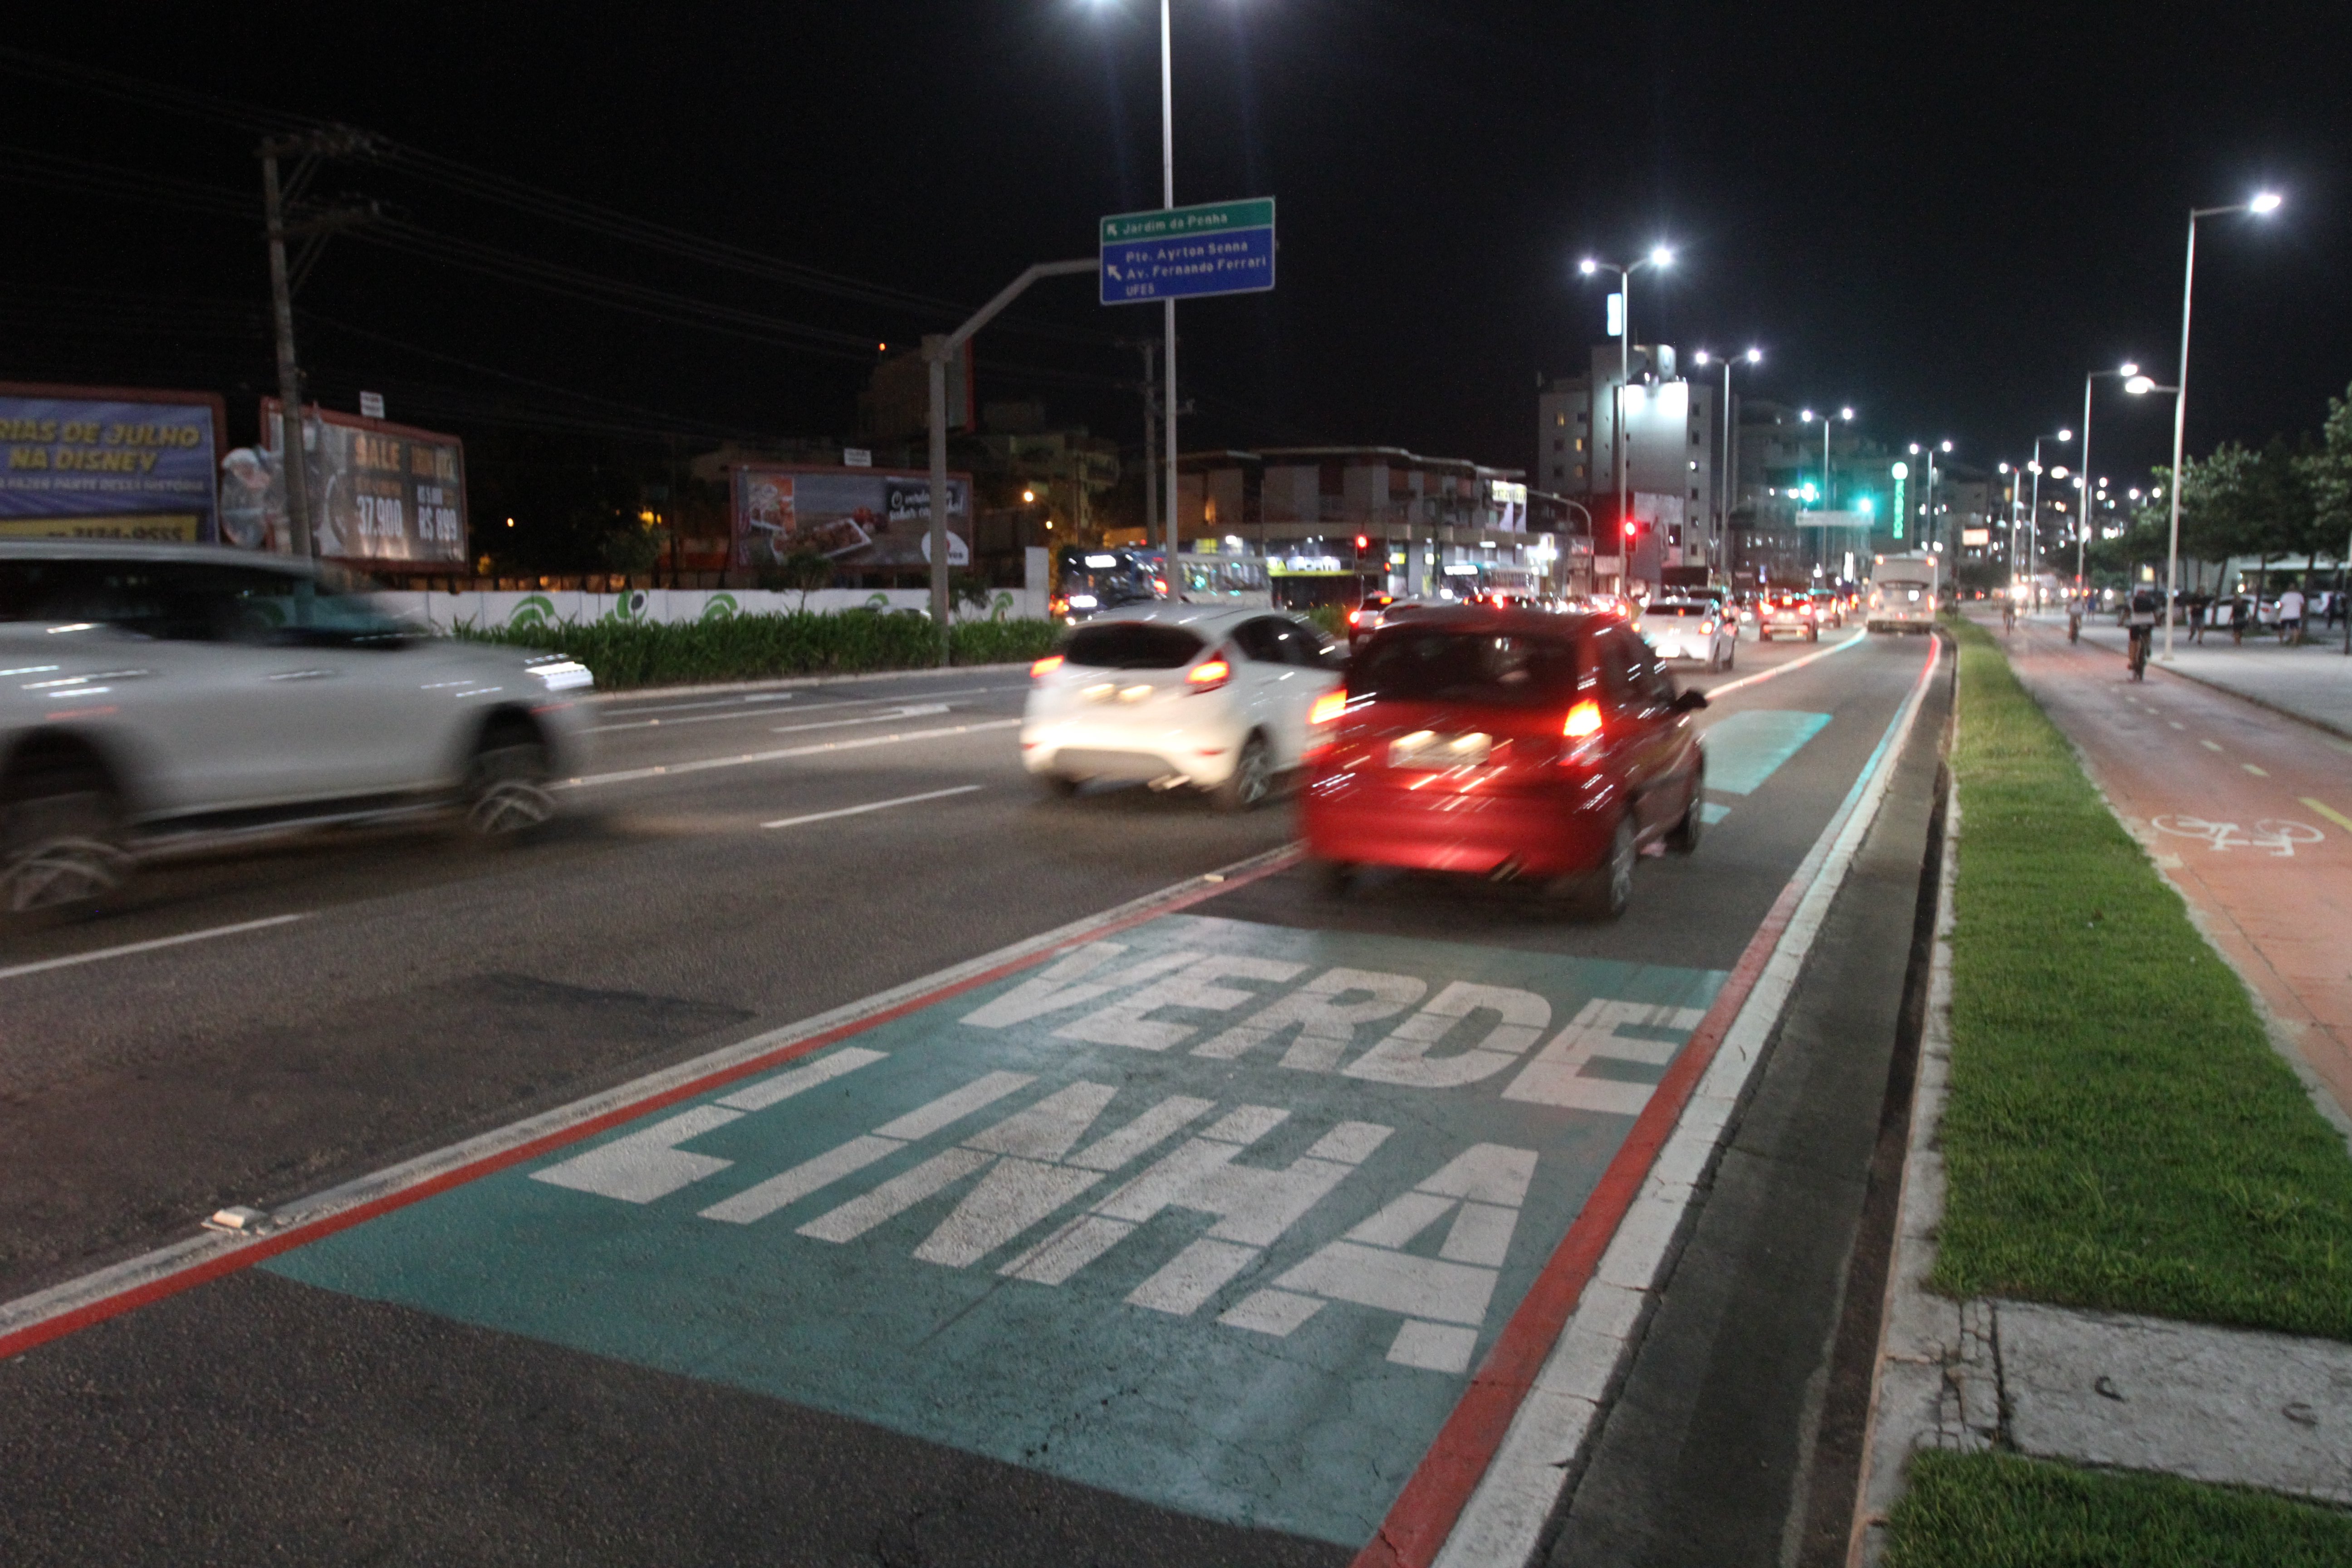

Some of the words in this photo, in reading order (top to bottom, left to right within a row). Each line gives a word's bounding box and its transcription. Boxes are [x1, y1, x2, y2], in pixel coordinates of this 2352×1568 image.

[1122, 218, 1166, 235] Jardim
[1170, 217, 1185, 229] da
[1187, 212, 1228, 228] Penha
[1126, 250, 1153, 263] Pte.
[1157, 246, 1205, 262] Ayrton
[1208, 241, 1249, 255] Senna
[1126, 267, 1150, 280] Av.
[1152, 262, 1214, 277] Fernando
[1217, 255, 1267, 270] Ferrari
[1126, 282, 1155, 297] UFES
[63, 421, 101, 445] DE
[106, 423, 200, 448] JULHO
[10, 446, 48, 470] NA
[55, 447, 159, 473] DISNEY
[958, 942, 1707, 1115] VERDE
[528, 1047, 1539, 1375] LINHA
